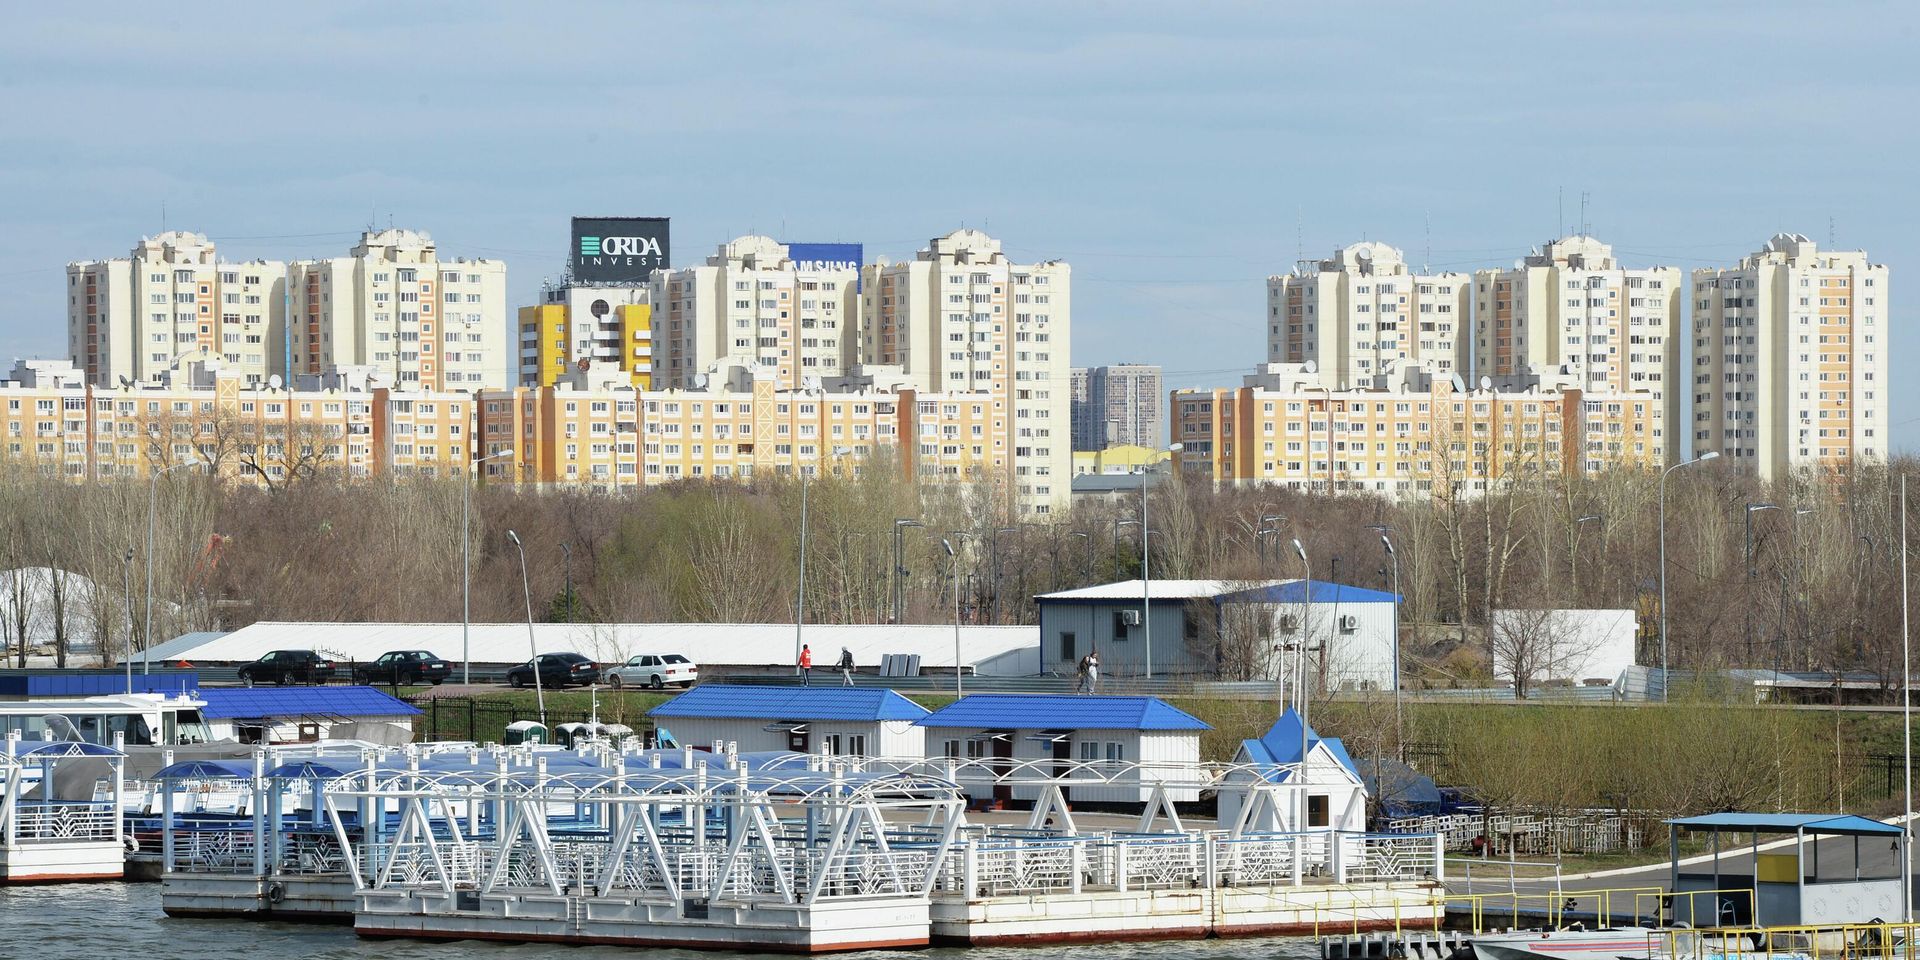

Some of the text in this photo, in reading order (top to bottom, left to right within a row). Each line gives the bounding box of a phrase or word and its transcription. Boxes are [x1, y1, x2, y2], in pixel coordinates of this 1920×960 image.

[602, 237, 662, 255] ORDA
[581, 257, 662, 266] INVEST
[791, 260, 858, 272] AMSUNG
